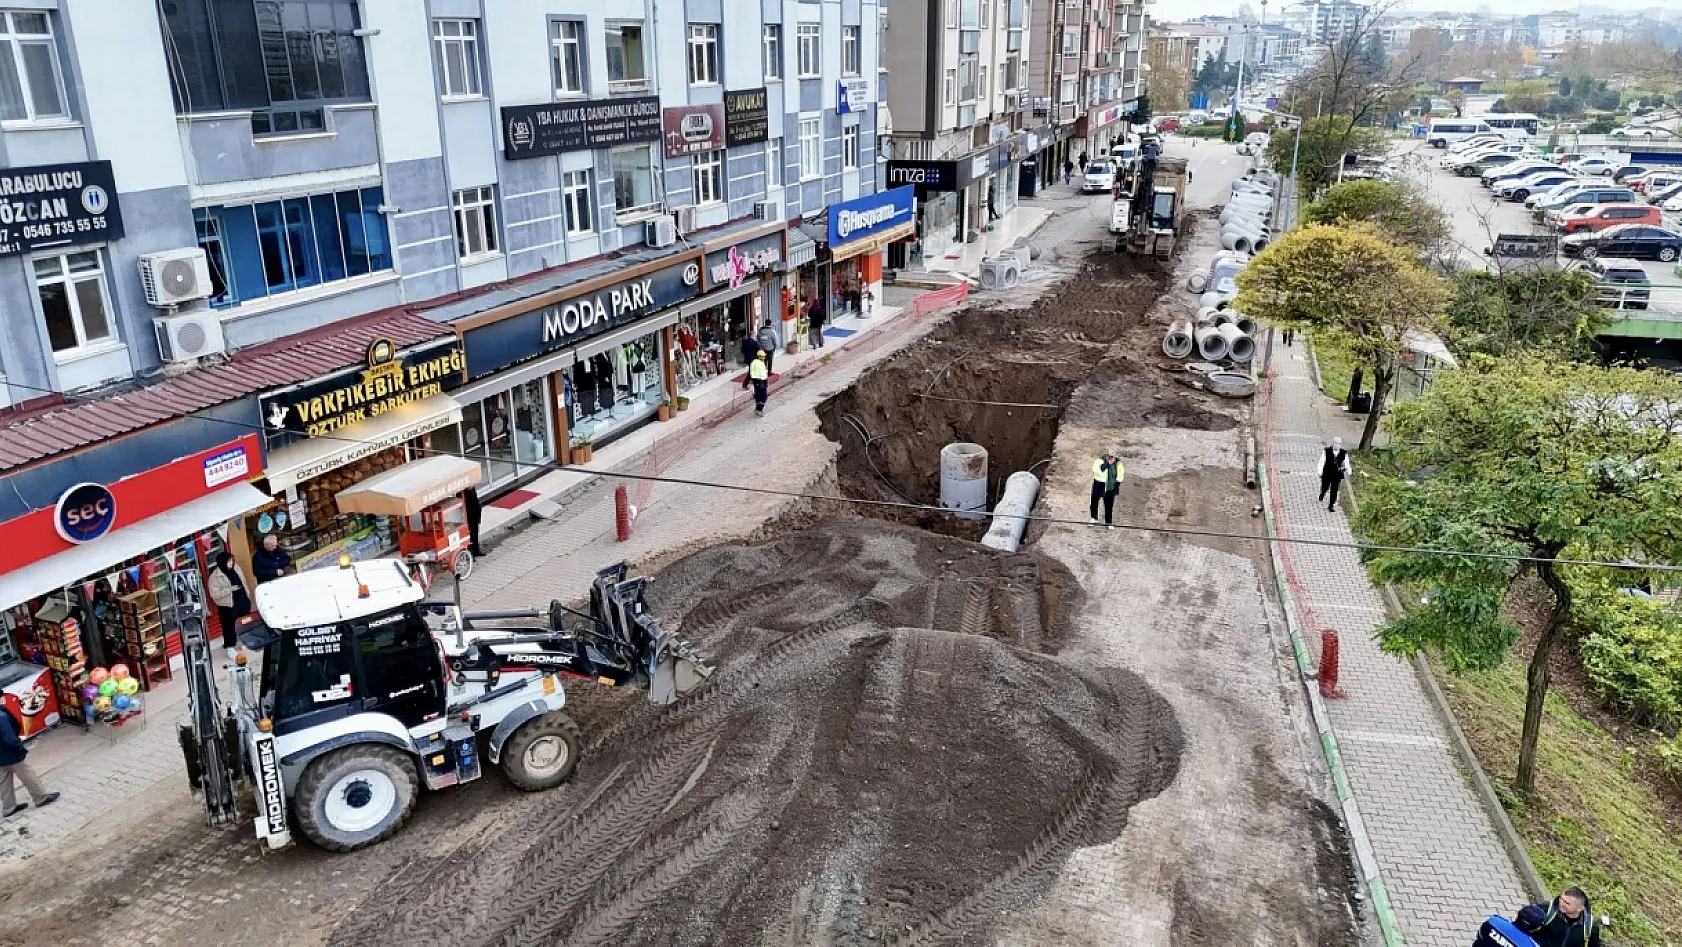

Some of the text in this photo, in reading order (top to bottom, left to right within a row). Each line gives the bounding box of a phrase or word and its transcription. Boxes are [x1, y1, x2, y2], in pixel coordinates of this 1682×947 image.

[736, 92, 765, 111] AVUKAT
[553, 108, 580, 124] HUKUK
[580, 107, 587, 121] &
[890, 165, 925, 182] imza
[0, 198, 68, 224] ÖZCAN
[23, 224, 52, 239] 0546
[53, 220, 75, 234] 735
[76, 217, 91, 231] 55
[92, 216, 107, 230] 55
[543, 278, 655, 342] MODA PARK
[67, 498, 109, 526] seç
